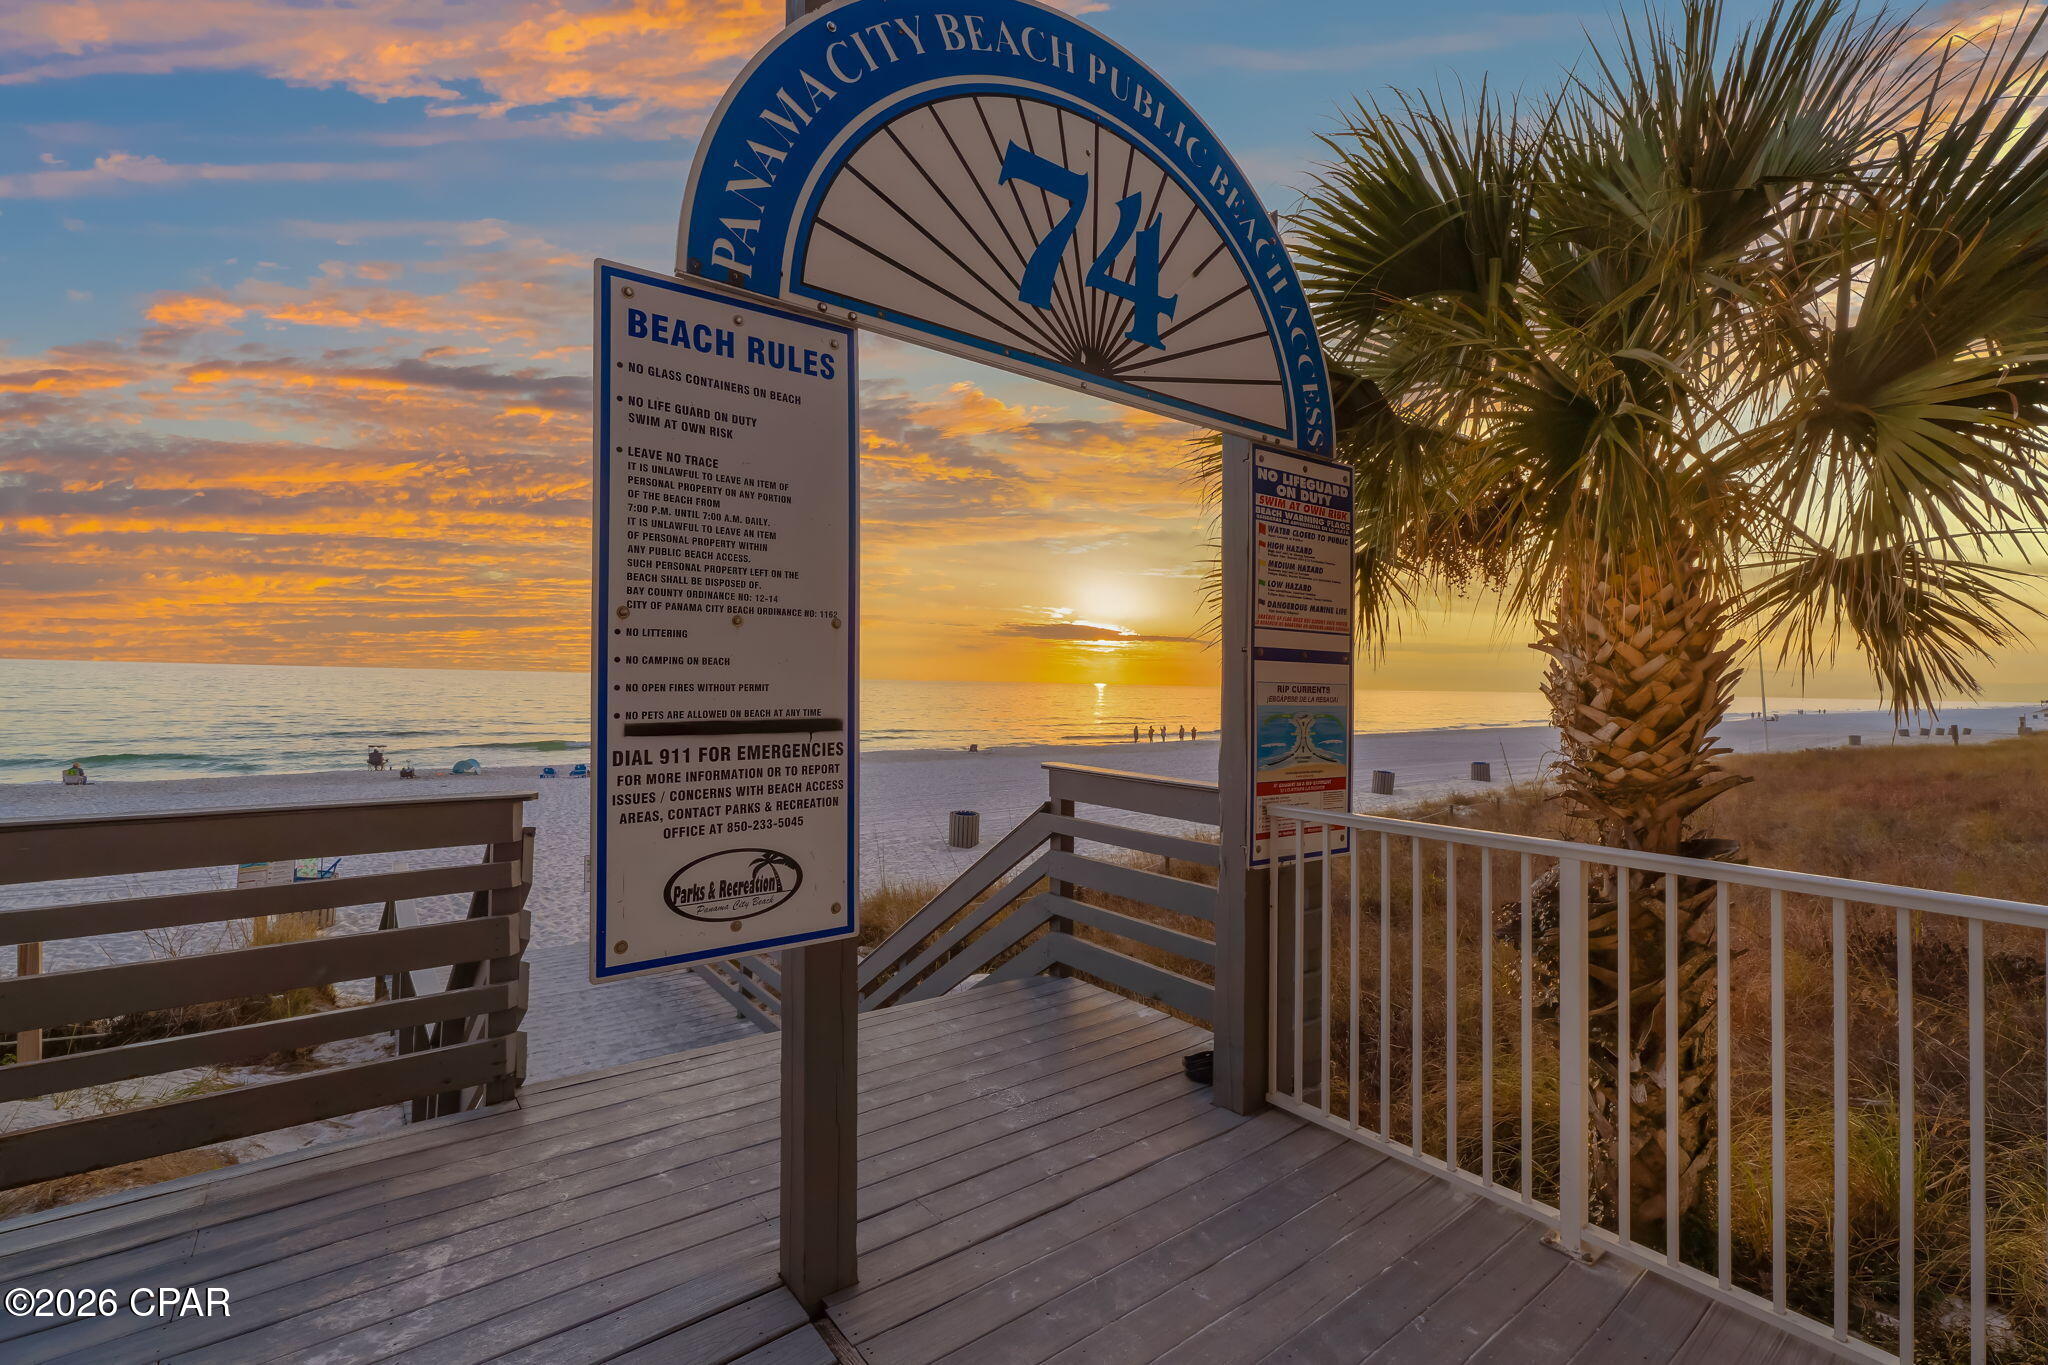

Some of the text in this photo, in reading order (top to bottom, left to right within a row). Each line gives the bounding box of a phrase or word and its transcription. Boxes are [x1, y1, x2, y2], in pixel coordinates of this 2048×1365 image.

[710, 13, 1325, 448] PANAMA CITY BEACH PUBLIC BEACH ACCESS
[998, 138, 1178, 351] 74
[628, 308, 835, 380] BEACH RULES
[628, 362, 801, 405] NO GLASS CONTAINERS ON BEACH
[628, 396, 757, 427] NO LIFE GUARD ON DUTY
[628, 413, 733, 439] SWIM AT OWN RISK
[628, 447, 719, 468] LEAVE NO TRACE
[628, 462, 789, 491] IT IS UNLAWFUL TO LEAVE AN ITEM OF
[1258, 467, 1348, 498] NO LIFEGUARD
[628, 476, 792, 504] PERSONAL PROPERTY ON ANY PORTION
[628, 490, 720, 508] OF THE BEACH FROM
[1277, 485, 1332, 505] ON DUTY
[628, 504, 770, 526] 7:00 P.M. UNTIL 7:00 A.M. DAILY.
[1256, 506, 1282, 517] BEACH
[1286, 512, 1324, 525] WARNING
[1327, 520, 1350, 530] FLAGS
[1260, 495, 1347, 520] SWIM AT OWN RISK
[628, 531, 768, 551] OF PERSONAL PROPERTY WITHIN
[1268, 525, 1290, 535] WATER
[1293, 530, 1315, 539] CLOSED
[1328, 536, 1348, 545] PUBLIC
[628, 545, 751, 563] ANY PUBLIC BEACH ACCESS.
[1268, 542, 1284, 550] HIGH
[1286, 545, 1312, 555] HAZARD
[627, 559, 799, 579] SUCH PERSONAL PROPERTY LEFT ON THE
[1268, 560, 1295, 570] MEDIUM
[1298, 565, 1323, 574] HAZARD
[627, 573, 761, 589] BEACH SHALL BE DISPOSED OF.
[1268, 580, 1311, 591] LOW HAZARD
[627, 587, 778, 602] BAY COUNTY ORDINANCE NO: 12-14
[1268, 601, 1307, 611] DANGEROUS
[1310, 604, 1334, 614] MARINE
[626, 628, 688, 638] NO LITTERING
[626, 656, 730, 666] NO CAMPING ON BEACH
[626, 684, 639, 692] NO
[642, 684, 666, 692] OPEN
[669, 684, 694, 692] FIRES
[697, 684, 736, 692] WITHOUT
[1277, 685, 1289, 693] RIP
[625, 708, 821, 720] NO PETS ARE ALLOWED ON BEACH AT ANY TIME
[612, 742, 844, 766] DIAL 911 FOR EMERGENCIES
[617, 764, 840, 786] FOR MORE INFORMATION OR TO REPORT
[612, 779, 844, 806] ISSUES CONCERNS WITH BEACH ACCESS
[620, 796, 839, 824] AREAS, CONTACT PARKS & RECREATION
[663, 816, 803, 839] OFFICE AT 850-233-5045
[673, 875, 775, 906] Parks & Recreation
[697, 896, 775, 915] Panama City Beach
